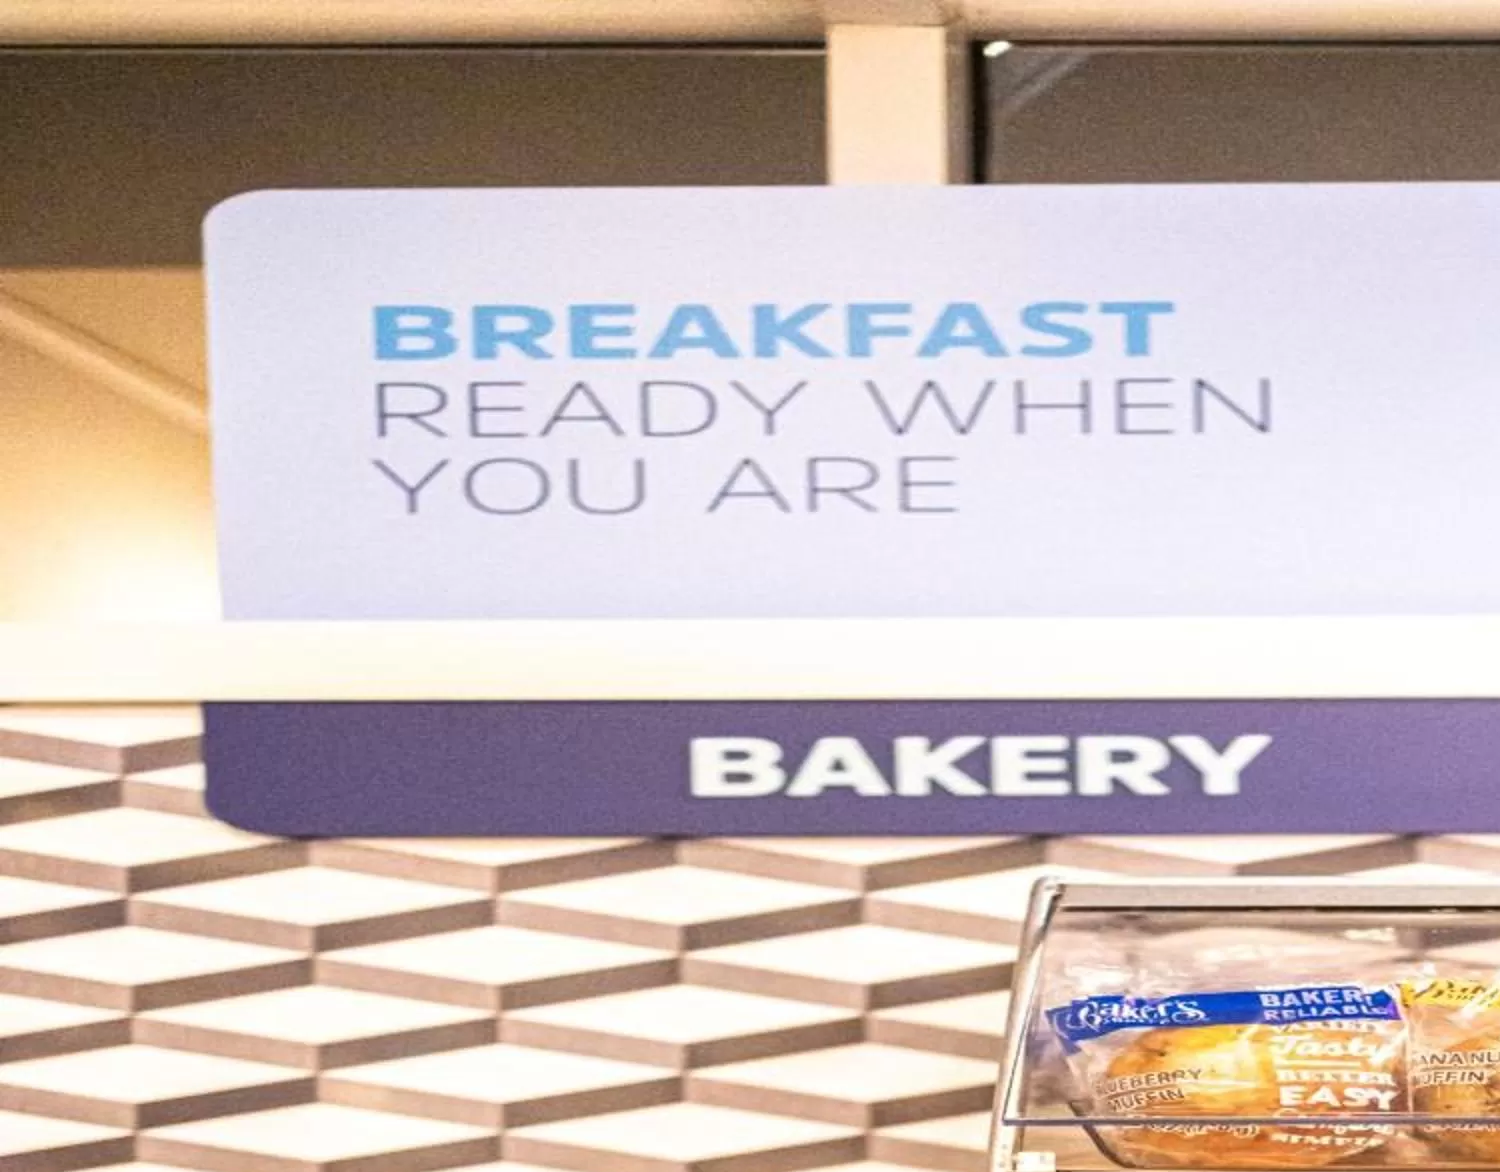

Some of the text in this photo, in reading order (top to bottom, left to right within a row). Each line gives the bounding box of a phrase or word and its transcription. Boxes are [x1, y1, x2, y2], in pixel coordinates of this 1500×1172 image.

[372, 301, 1176, 361] BREAKFAST
[373, 376, 1275, 440] READY WHEN
[371, 455, 961, 516] YOU ARE
[688, 734, 1274, 798] BAKERY
[1279, 1085, 1400, 1110] EASY
